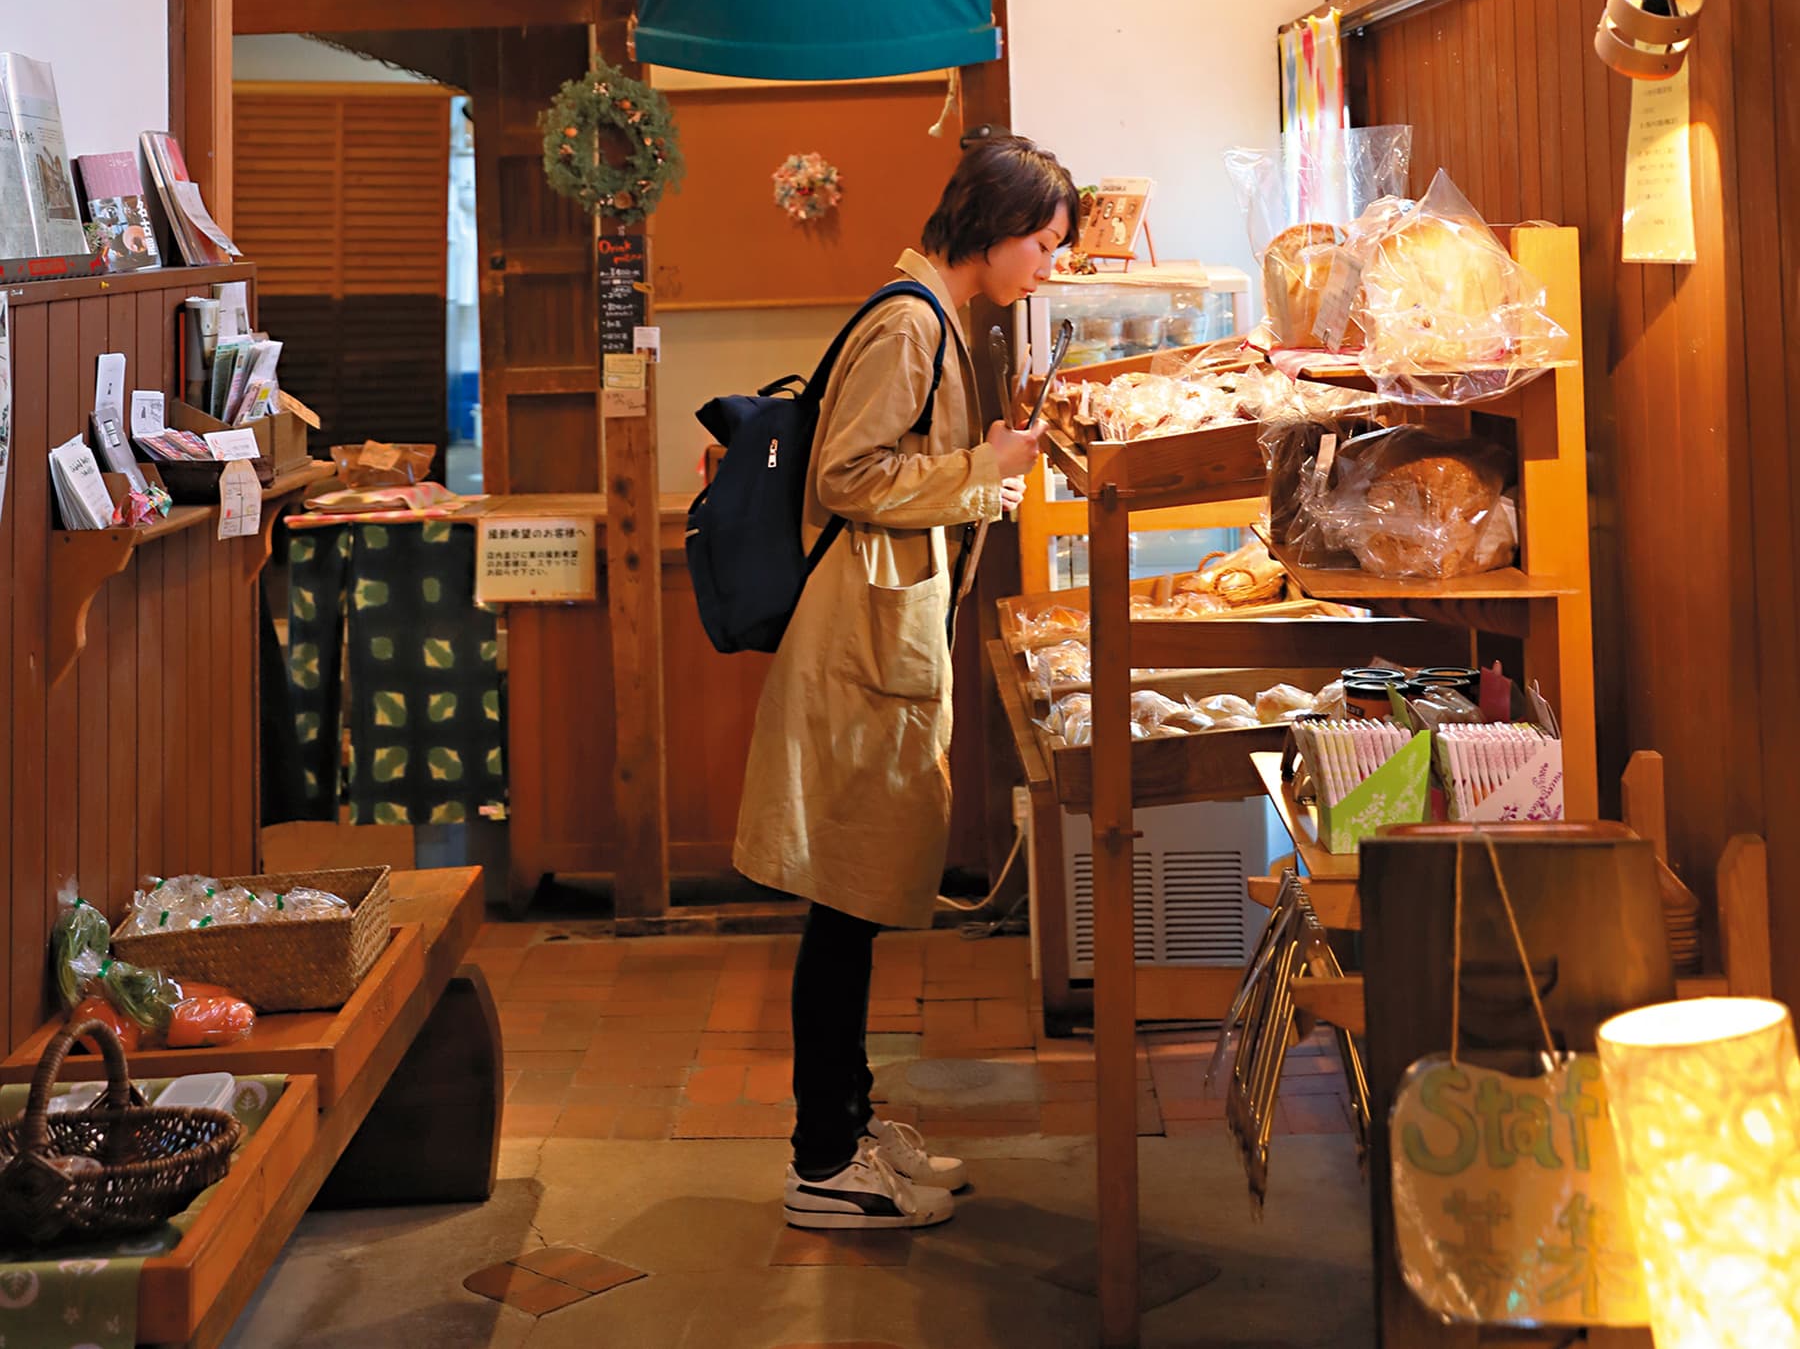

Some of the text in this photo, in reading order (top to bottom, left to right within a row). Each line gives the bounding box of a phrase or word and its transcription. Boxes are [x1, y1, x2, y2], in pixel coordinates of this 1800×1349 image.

[487, 528, 587, 539] 撮影希望のお客様へ
